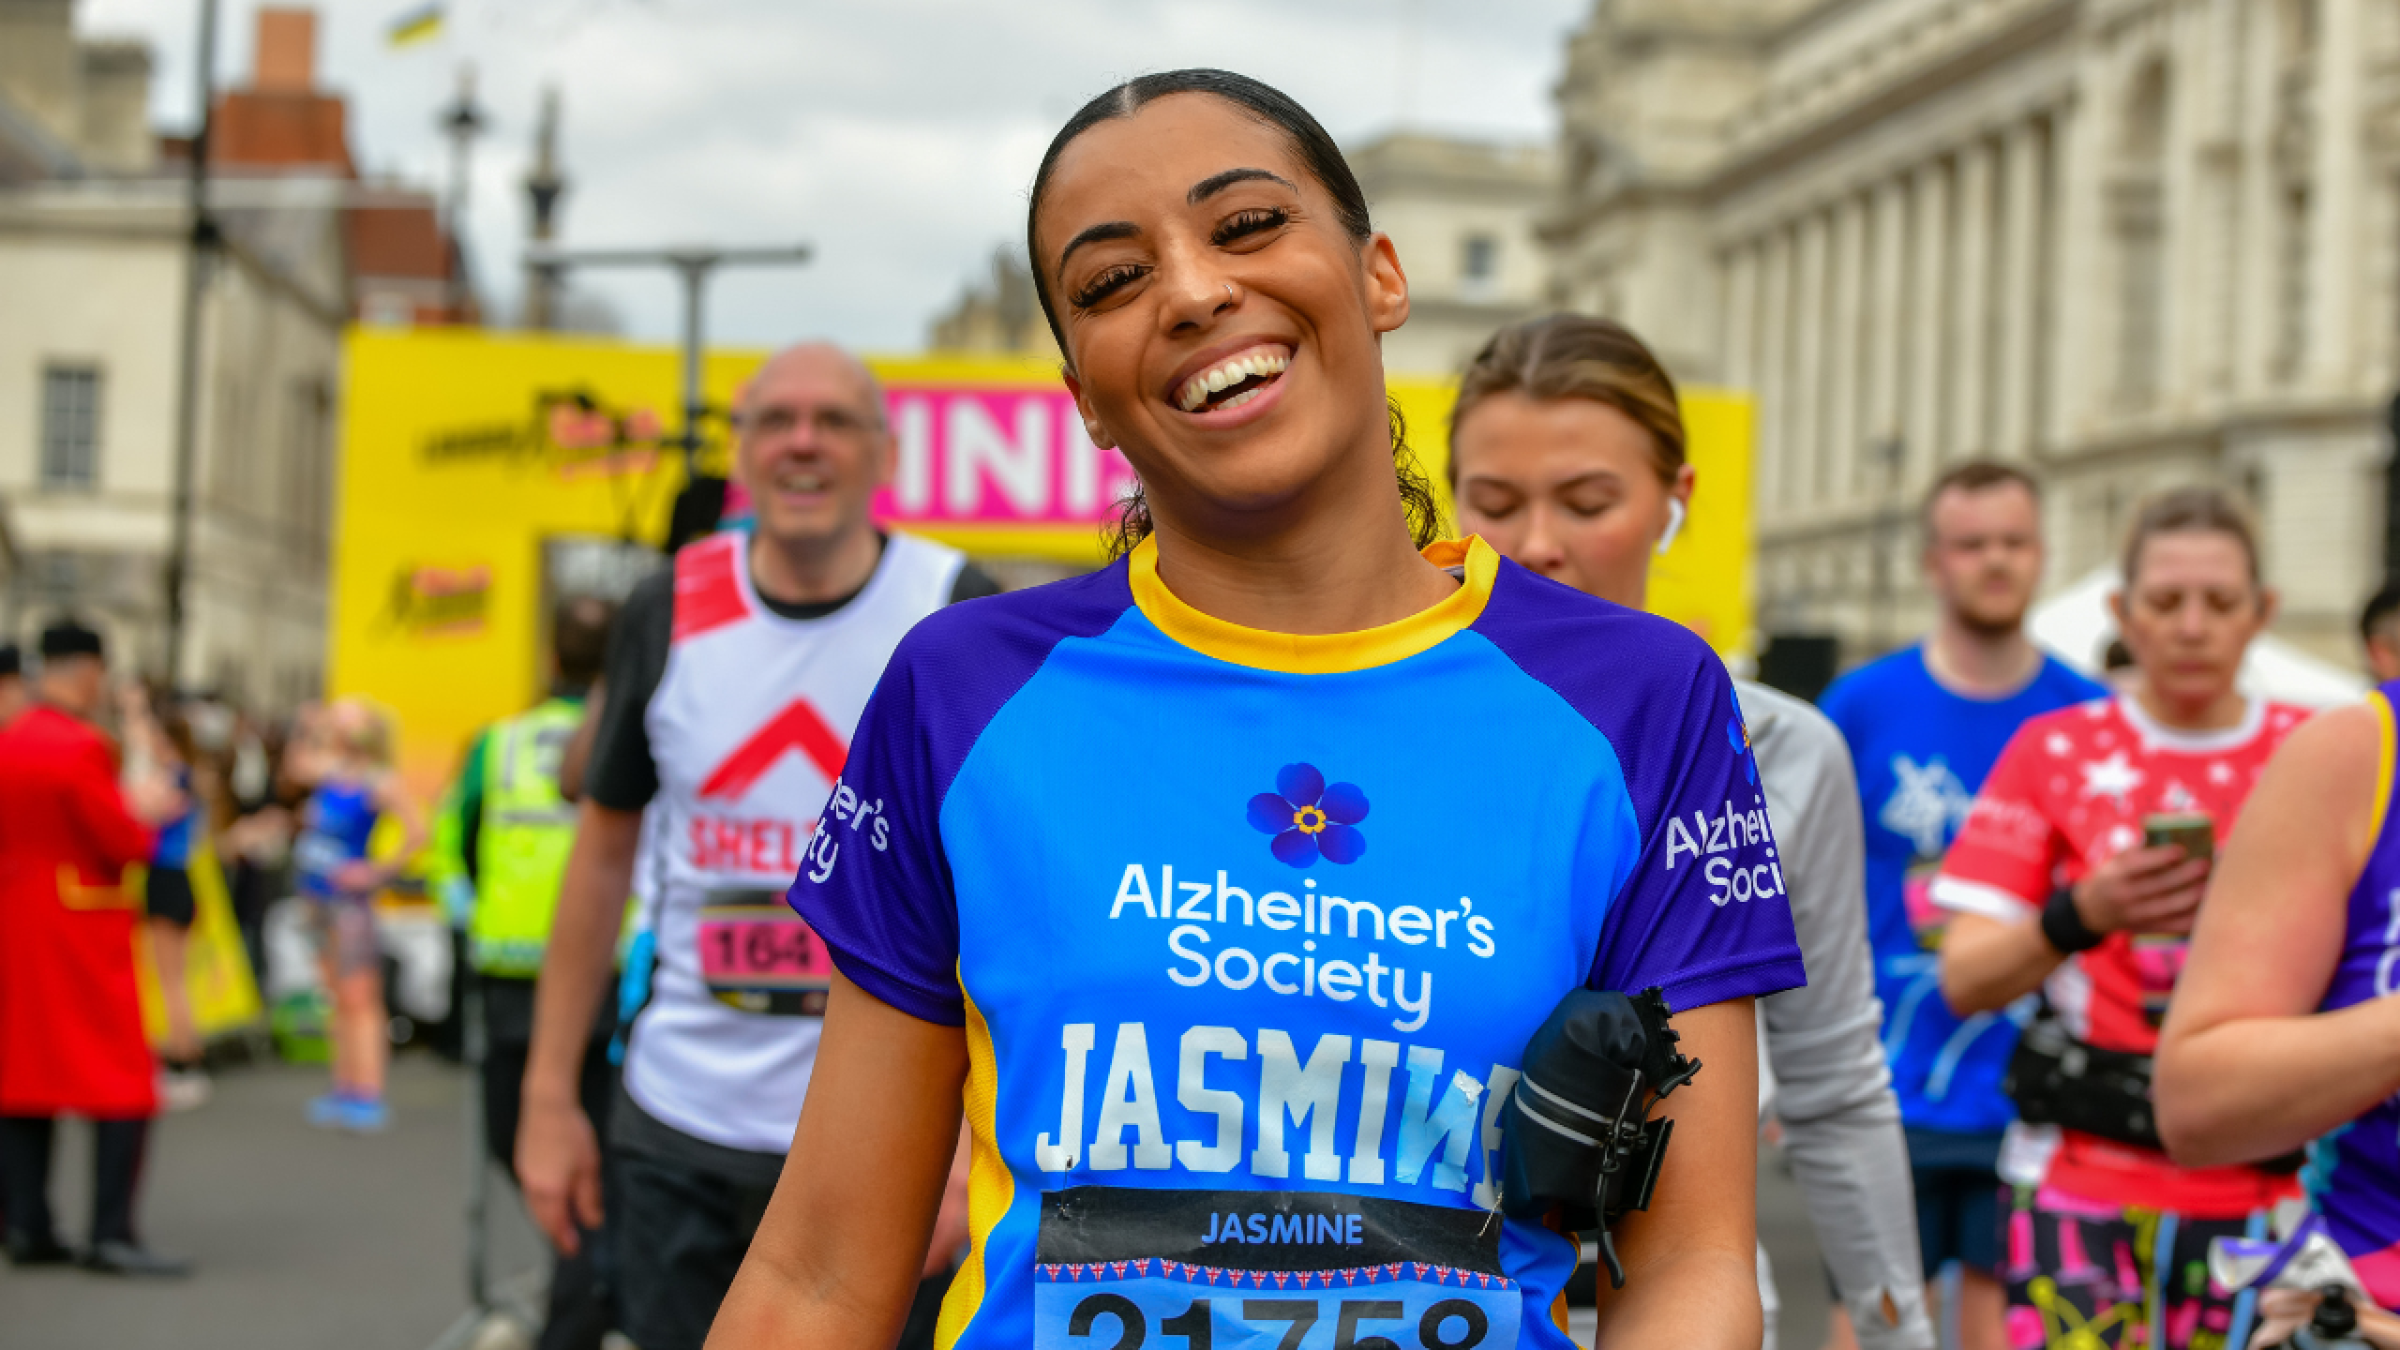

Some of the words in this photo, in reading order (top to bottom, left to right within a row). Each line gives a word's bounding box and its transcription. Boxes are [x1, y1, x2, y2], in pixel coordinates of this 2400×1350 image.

[896, 397, 1136, 516] INI
[690, 818, 817, 873] SHEL
[1665, 793, 1774, 870] Alzhei
[1109, 863, 1495, 958] Alzheimer's
[1167, 925, 1432, 1032] Society
[1201, 1213, 1363, 1245] JASMINE
